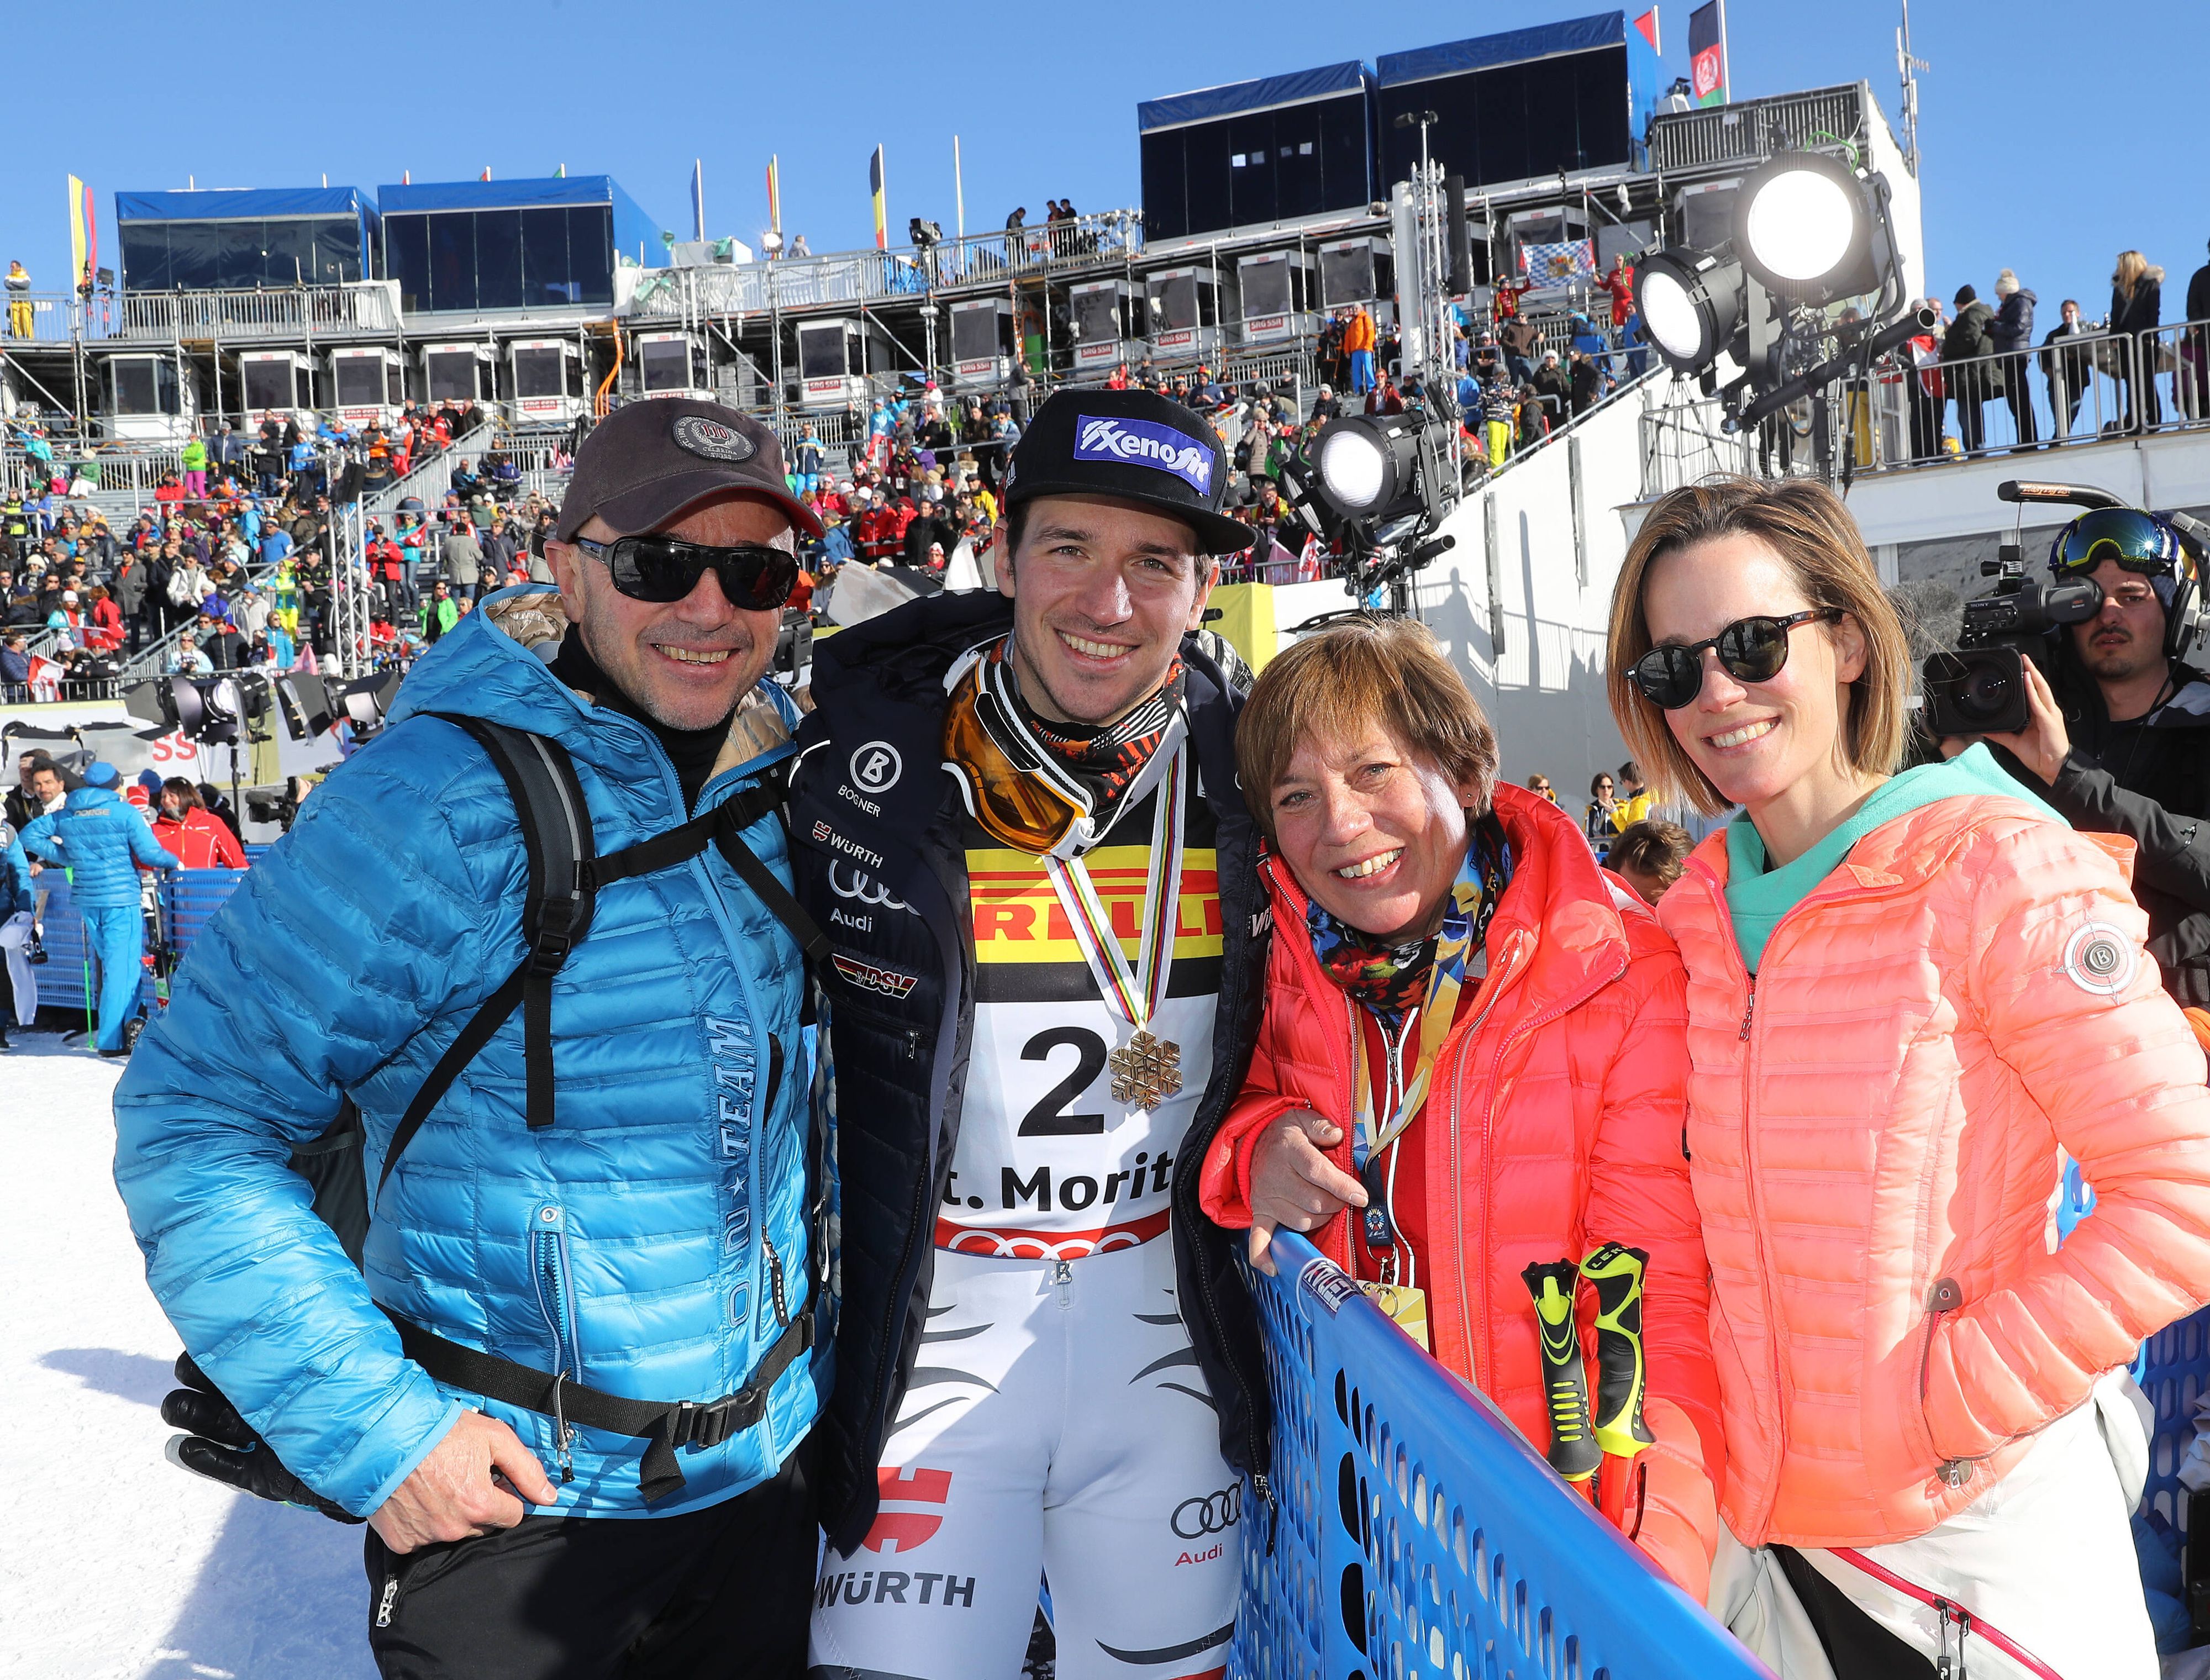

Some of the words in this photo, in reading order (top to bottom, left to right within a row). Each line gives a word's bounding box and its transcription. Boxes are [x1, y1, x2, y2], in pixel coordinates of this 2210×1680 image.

[1251, 321, 1266, 329] SRG
[1267, 318, 1282, 327] SSR
[1082, 347, 1097, 355] SRG
[1097, 345, 1112, 354] SSR
[1160, 335, 1175, 343] SRG
[1175, 333, 1190, 341] SSR
[977, 362, 990, 371] SSR
[702, 424, 729, 440] 110
[838, 784, 881, 818] BOGNER
[830, 833, 883, 868] WÜRTH
[830, 908, 872, 933] Audi
[866, 967, 919, 999] DSV
[705, 1017, 757, 1158] TEAM
[1017, 1026, 1107, 1137] 2
[1001, 1151, 1174, 1212] Morit
[1592, 1245, 1629, 1269] LEKI
[1633, 1381, 1646, 1431] LEKI
[1174, 1542, 1224, 1567] Audi
[818, 1570, 976, 1608] WÜRTH
